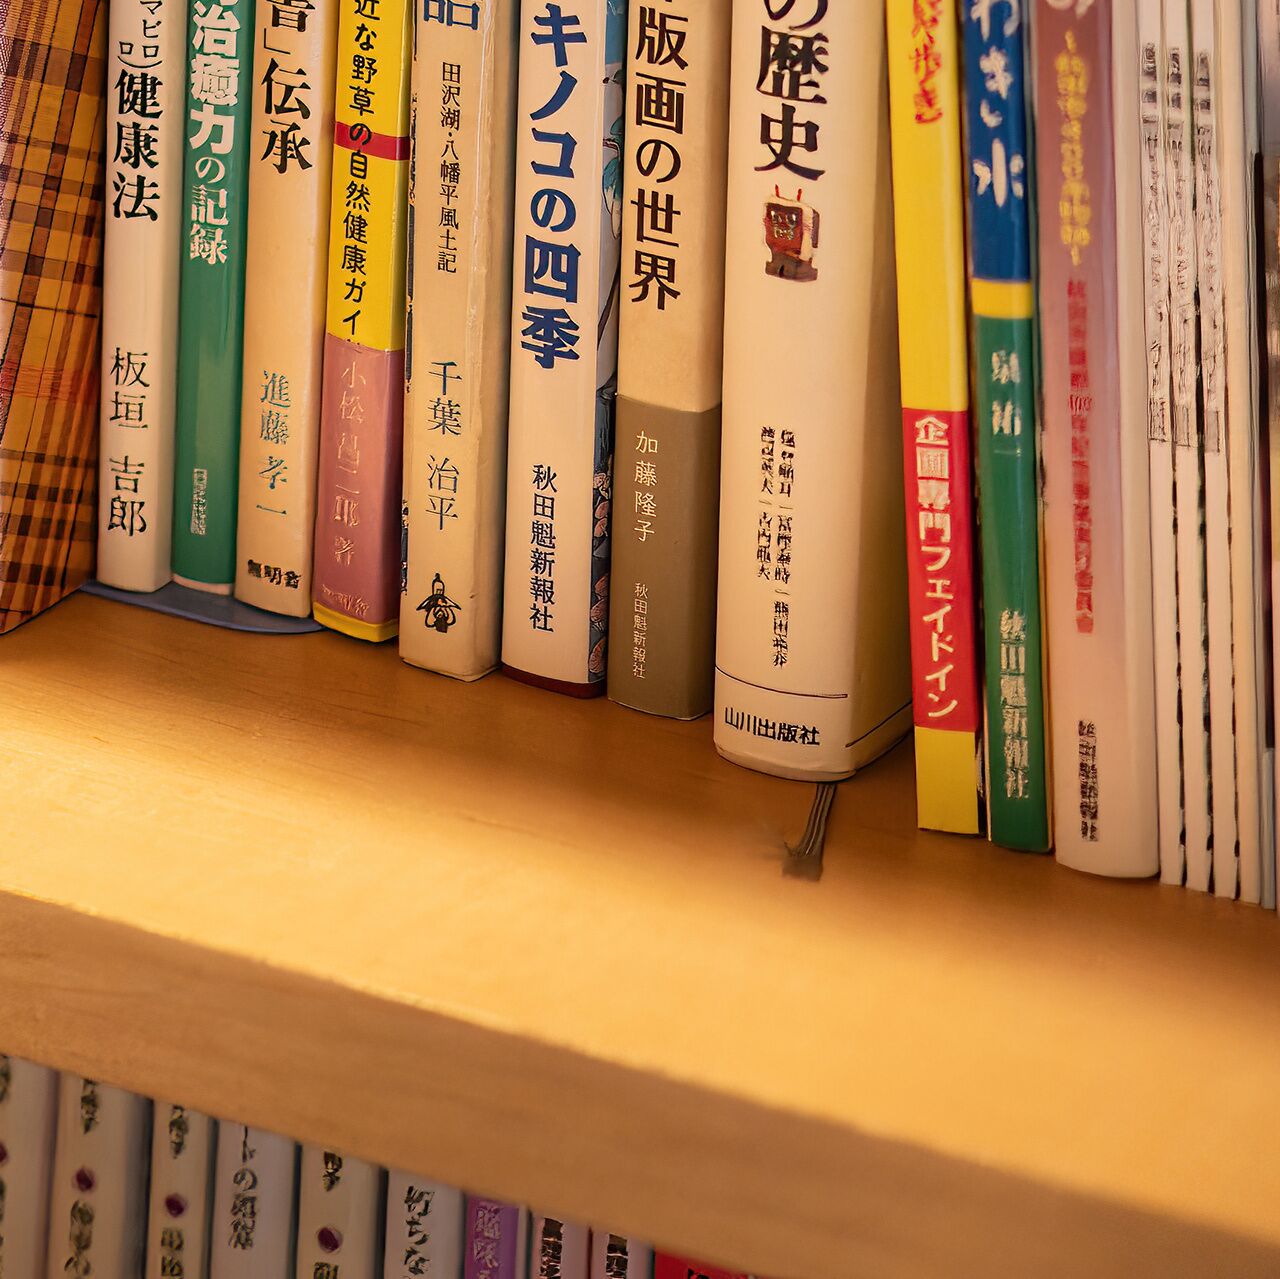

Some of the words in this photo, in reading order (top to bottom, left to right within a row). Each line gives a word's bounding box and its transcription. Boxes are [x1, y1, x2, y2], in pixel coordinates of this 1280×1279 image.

[111, 68, 164, 222] 健康法
[437, 60, 463, 274] 田沢湖・八幡平風土記
[519, 1, 588, 370] キノコの四季
[109, 346, 151, 431] 板垣
[427, 360, 464, 437] 千葉
[107, 456, 147, 538] 吉郎
[423, 455, 461, 532] 治平
[634, 430, 658, 542] 加藤隆子
[529, 463, 558, 634] 秋田魁新報社
[632, 582, 649, 679] 秋田魁新報社
[723, 707, 821, 747] 山川出版社
